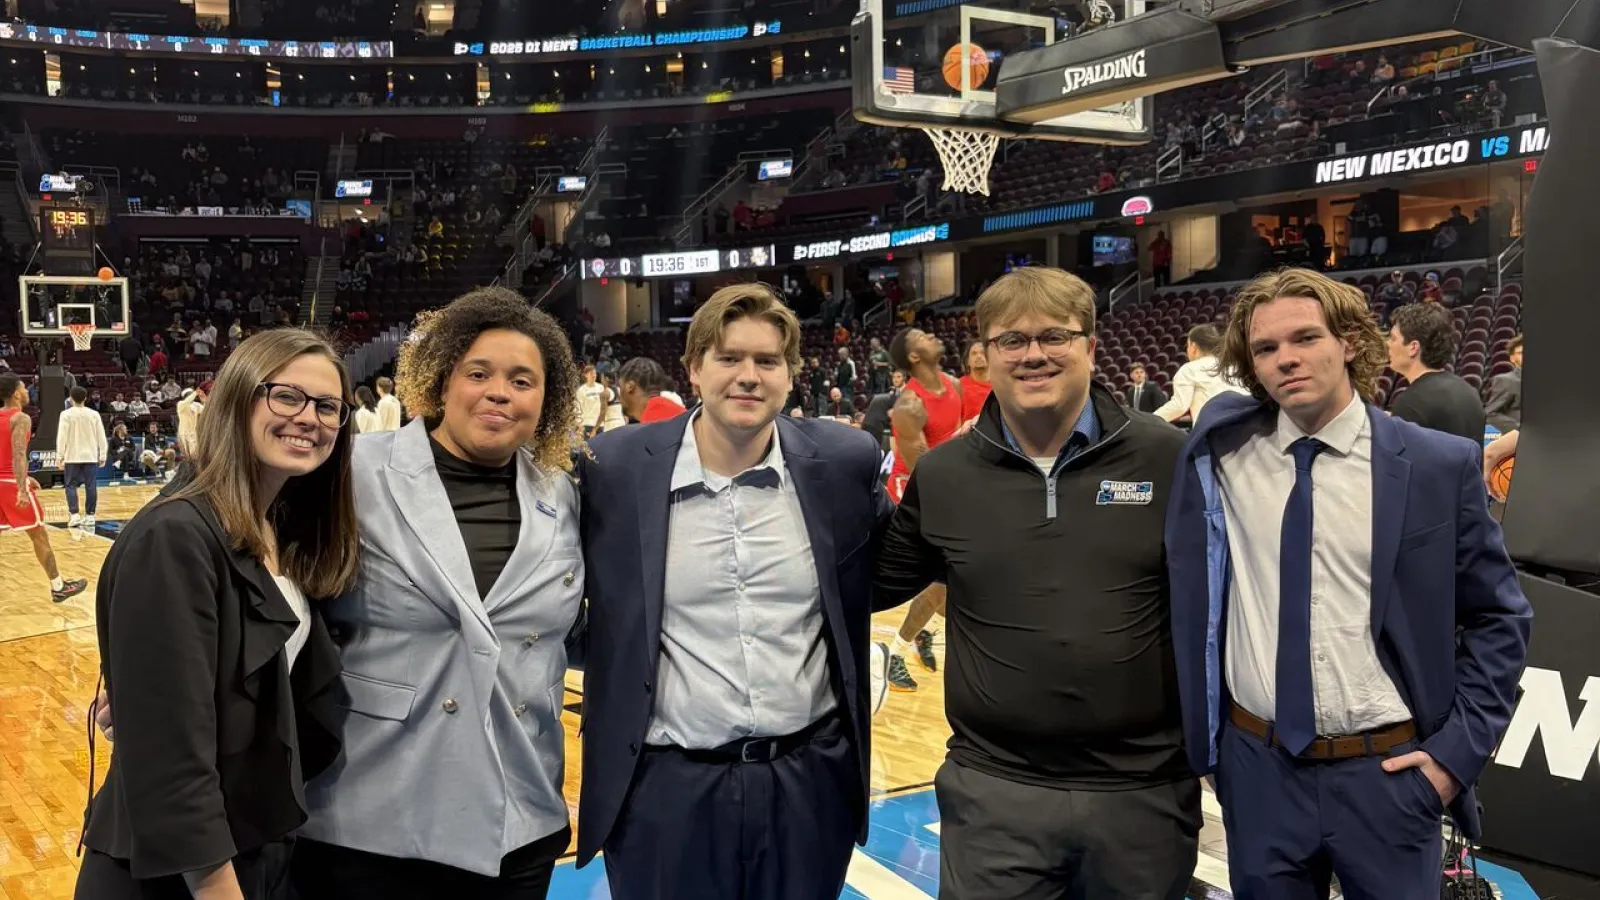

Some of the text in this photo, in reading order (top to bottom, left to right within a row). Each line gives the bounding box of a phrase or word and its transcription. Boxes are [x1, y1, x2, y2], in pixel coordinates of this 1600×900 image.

[54, 35, 62, 44] 0
[136, 41, 142, 50] 1
[210, 44, 223, 54] 10
[490, 26, 748, 54] 2025 DI MEN'S BASKETBALL CHAMPIONSHIP
[1061, 48, 1147, 94] SPALDING
[1315, 156, 1367, 184] NEW
[1370, 139, 1470, 176] MEXICO
[1481, 135, 1510, 158] VS
[53, 211, 87, 225] 19:36
[807, 240, 842, 259] FIRST
[849, 232, 891, 253] SECOND
[891, 225, 936, 247] ROUNDS
[620, 257, 631, 276] 0
[649, 257, 685, 273] 19:36
[695, 256, 710, 268] 1ST
[729, 249, 740, 268] 0
[1111, 482, 1137, 492] MARCH
[1114, 491, 1151, 502] MADNESS
[1494, 666, 1600, 781] N
